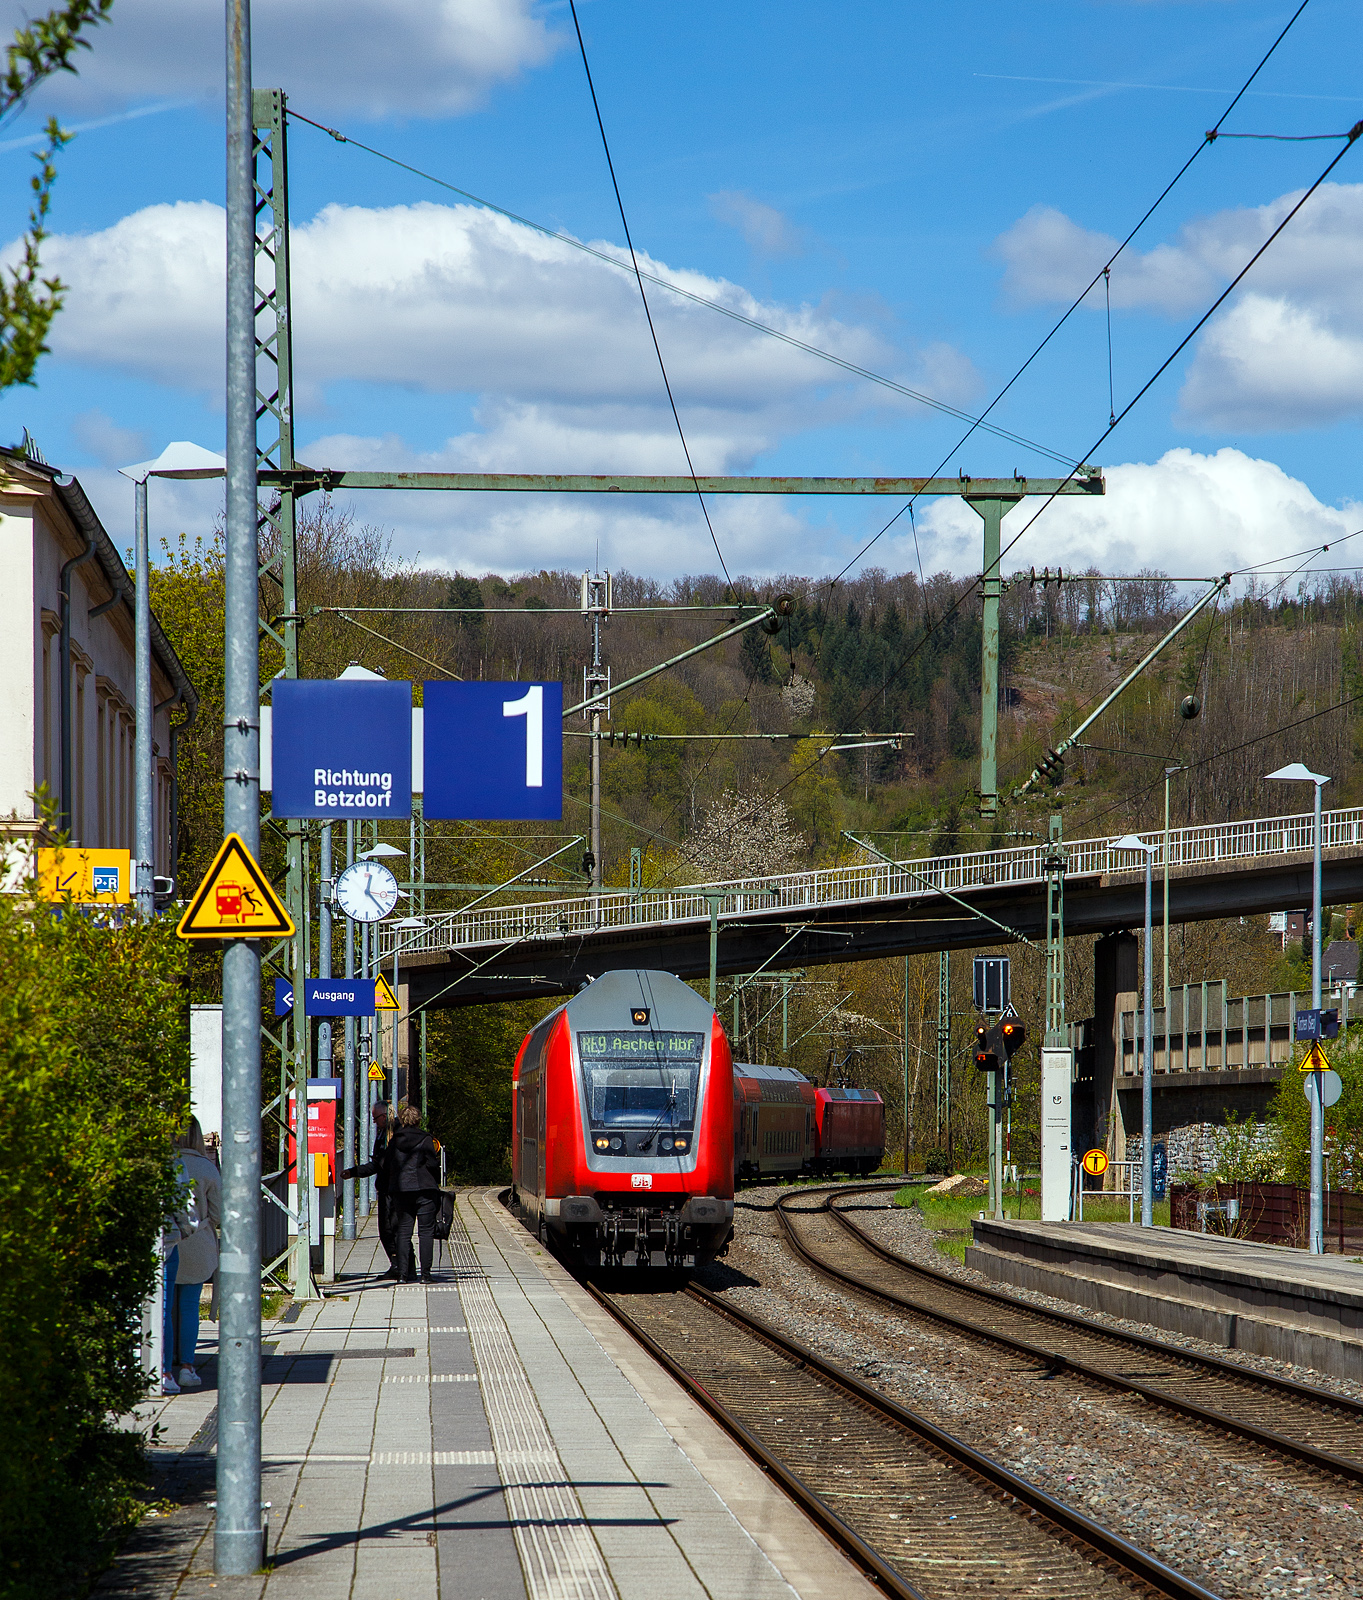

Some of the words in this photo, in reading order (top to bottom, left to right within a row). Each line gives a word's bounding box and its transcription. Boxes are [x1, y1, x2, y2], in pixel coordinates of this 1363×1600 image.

[502, 685, 544, 788] 1
[314, 769, 393, 790] Richtung
[314, 790, 391, 807] Betzdorf
[312, 990, 355, 1002] Ausgang
[582, 1036, 606, 1053] RE9
[613, 1037, 665, 1051] Aachen
[669, 1038, 695, 1051] Hbf
